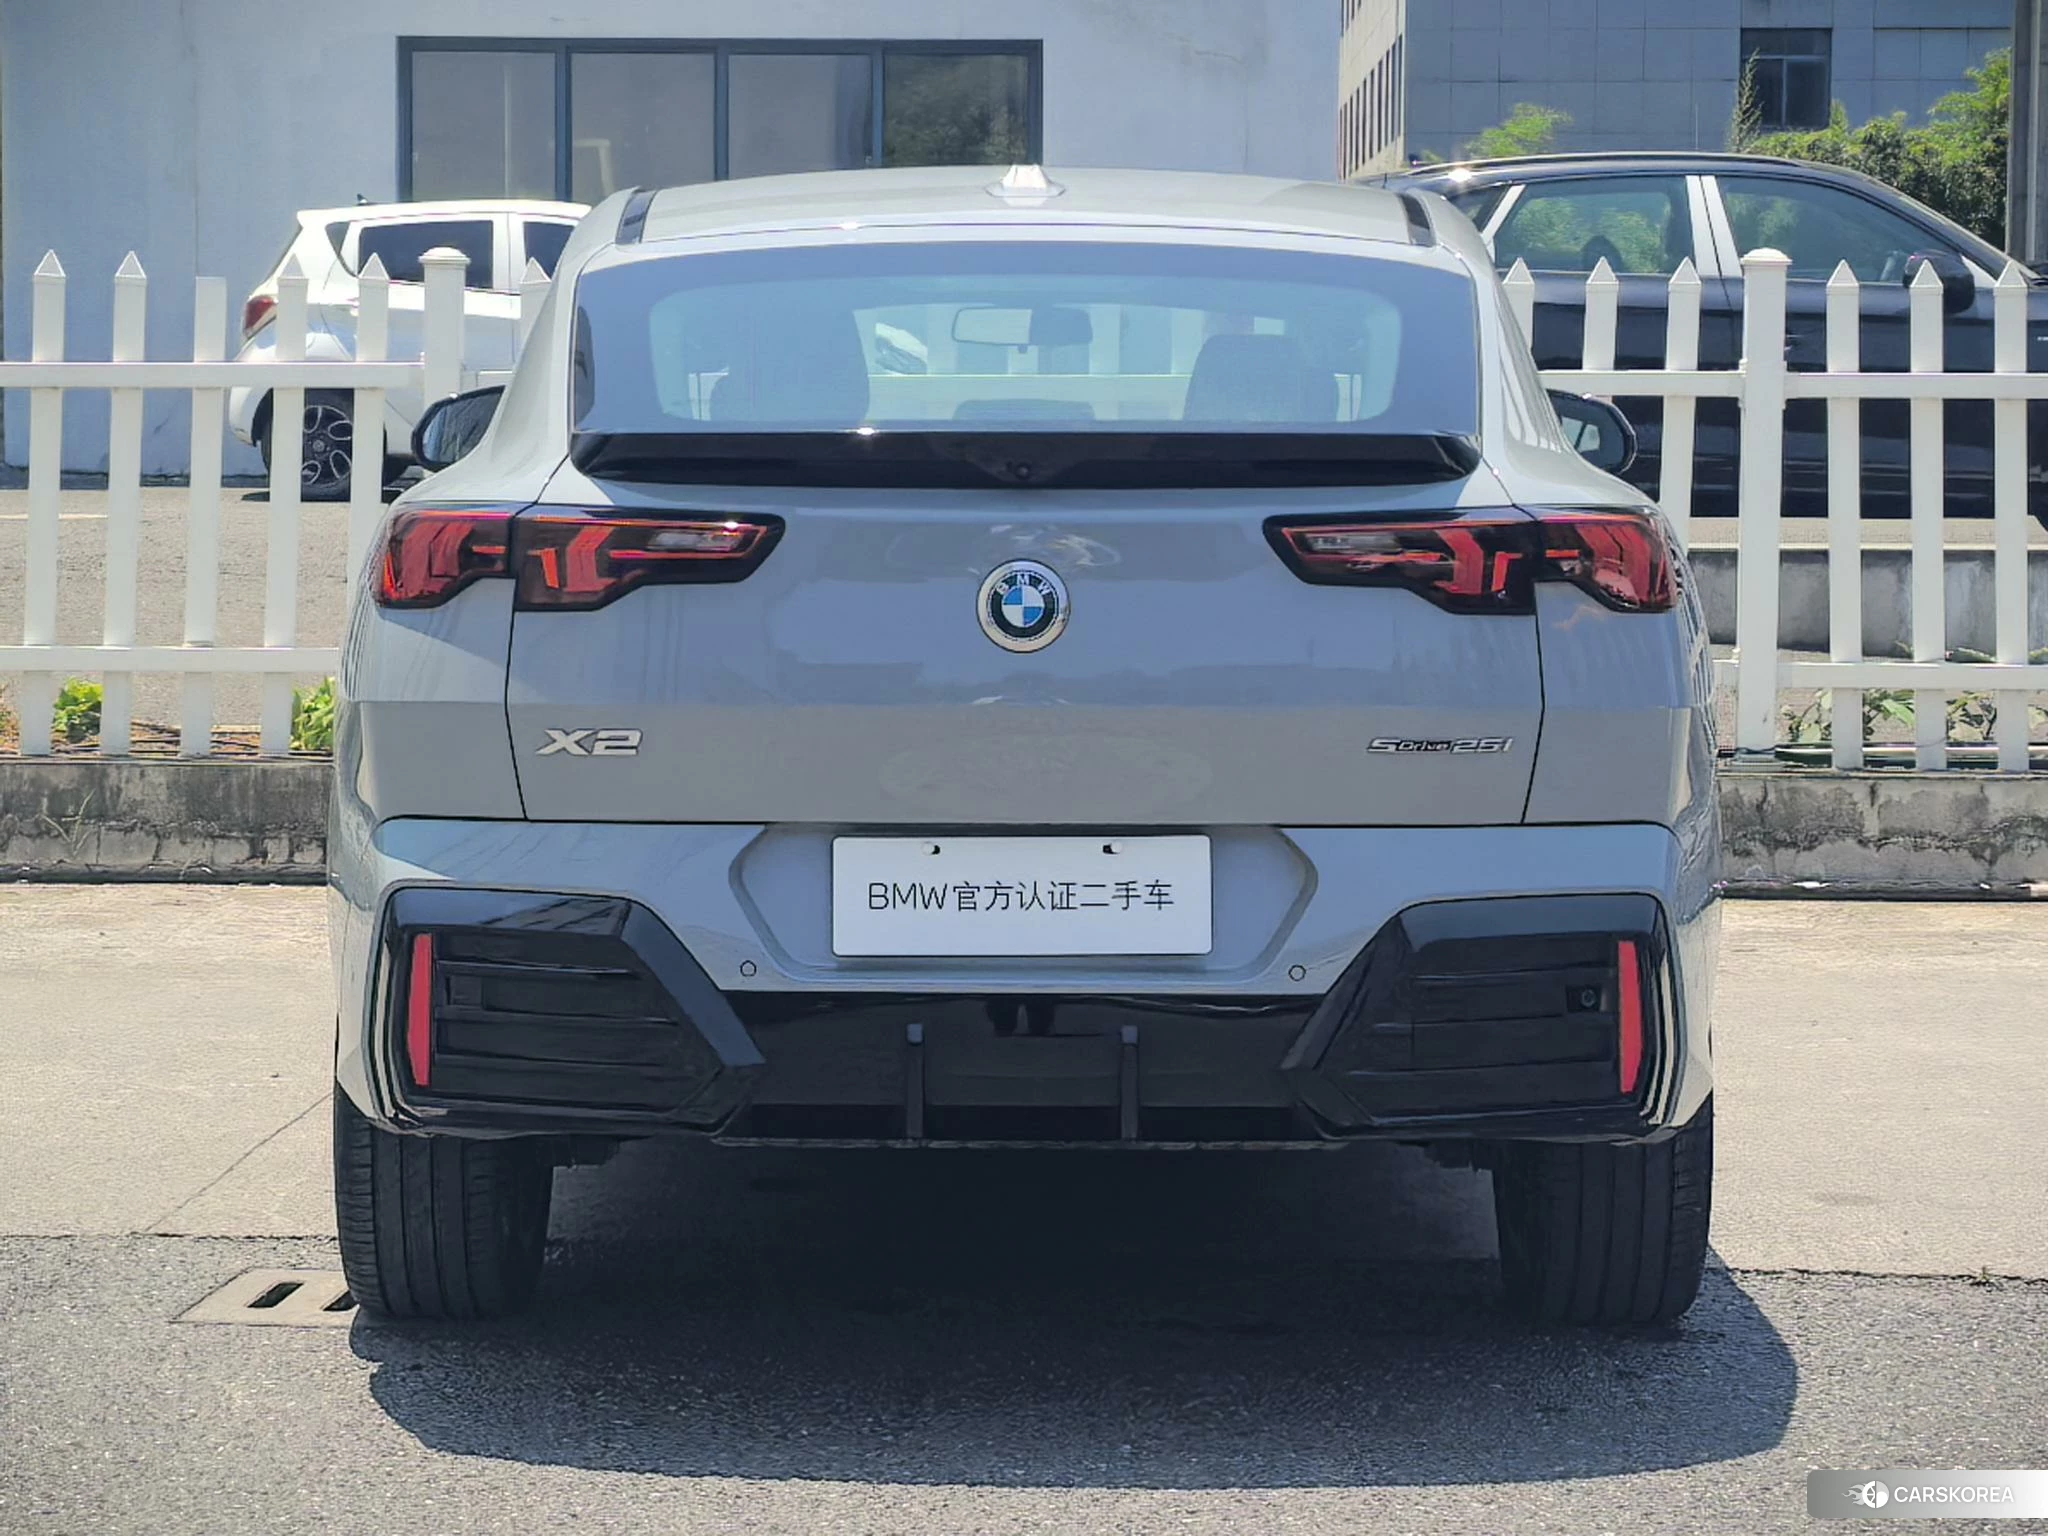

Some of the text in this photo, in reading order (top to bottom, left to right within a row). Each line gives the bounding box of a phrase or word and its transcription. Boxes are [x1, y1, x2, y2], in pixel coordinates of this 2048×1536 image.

[995, 572, 1051, 596] BMW
[535, 728, 643, 757] X2
[867, 879, 1175, 912] BMW官方认证二手车
